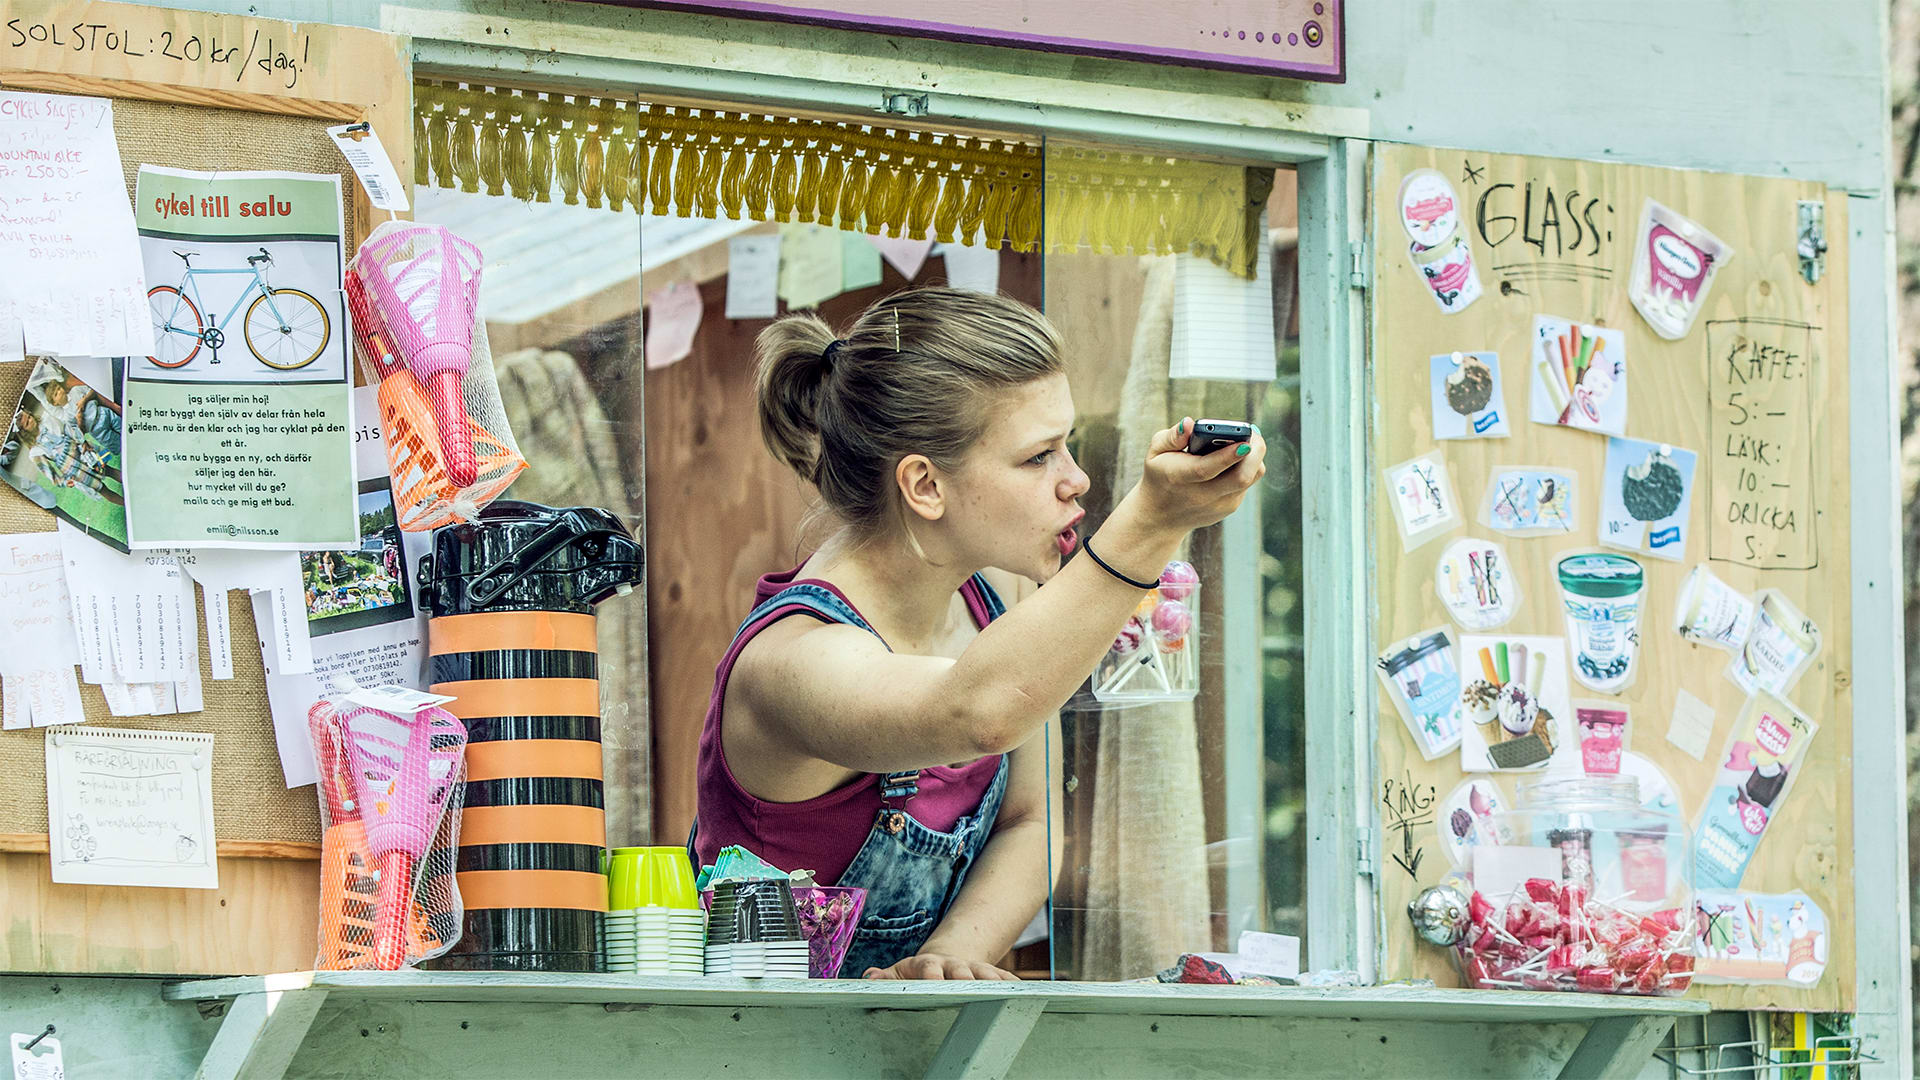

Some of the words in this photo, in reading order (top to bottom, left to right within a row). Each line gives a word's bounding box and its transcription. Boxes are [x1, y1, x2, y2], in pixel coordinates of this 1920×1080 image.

[155, 192, 195, 219] cykel
[200, 195, 229, 218] till
[239, 194, 292, 217] salu
[1476, 182, 1614, 258] GLASS:
[1728, 341, 1805, 385] KAFFE:
[187, 393, 203, 405] jag
[205, 393, 230, 405] säljer
[232, 395, 250, 404] min
[251, 394, 270, 405] hoj!
[138, 407, 152, 419] jag
[153, 407, 168, 418] har
[169, 407, 196, 420] byggt
[198, 407, 216, 418] den
[217, 407, 239, 420] själv
[241, 410, 253, 419] av
[255, 408, 279, 419] delar
[281, 407, 301, 419] från
[303, 408, 326, 419] hela
[162, 424, 175, 433] nu
[176, 422, 186, 433] är
[187, 422, 206, 433] den
[207, 422, 225, 433] klar
[226, 422, 243, 433] och
[244, 423, 260, 435] jag
[262, 423, 278, 433] har
[279, 422, 308, 435] cyklat
[310, 421, 324, 436] på
[326, 422, 346, 434] den
[220, 438, 232, 449] ett
[234, 438, 248, 449] år.
[154, 451, 170, 464] jag
[171, 451, 188, 463] ska
[189, 454, 201, 463] nu
[202, 452, 232, 466] bygga
[233, 454, 246, 463] en
[248, 454, 264, 467] ny,
[265, 452, 282, 463] och
[283, 452, 312, 463] därför
[194, 466, 220, 480] säljer
[221, 467, 236, 480] jag
[237, 467, 256, 478] den
[257, 467, 277, 478] här.
[187, 480, 203, 492] hur
[205, 481, 236, 494] mycket
[238, 481, 253, 492] vill
[255, 481, 268, 492] du
[269, 482, 287, 495] ge?
[183, 495, 209, 506] maila
[210, 496, 226, 507] och
[227, 498, 239, 510] ge
[241, 496, 259, 510] mig
[260, 496, 273, 507] ett
[274, 496, 295, 507] bud.
[1728, 502, 1796, 533] DRICKA
[206, 523, 280, 538] emili@nilsson.se
[347, 658, 366, 668] eller
[370, 652, 398, 664] bilplats
